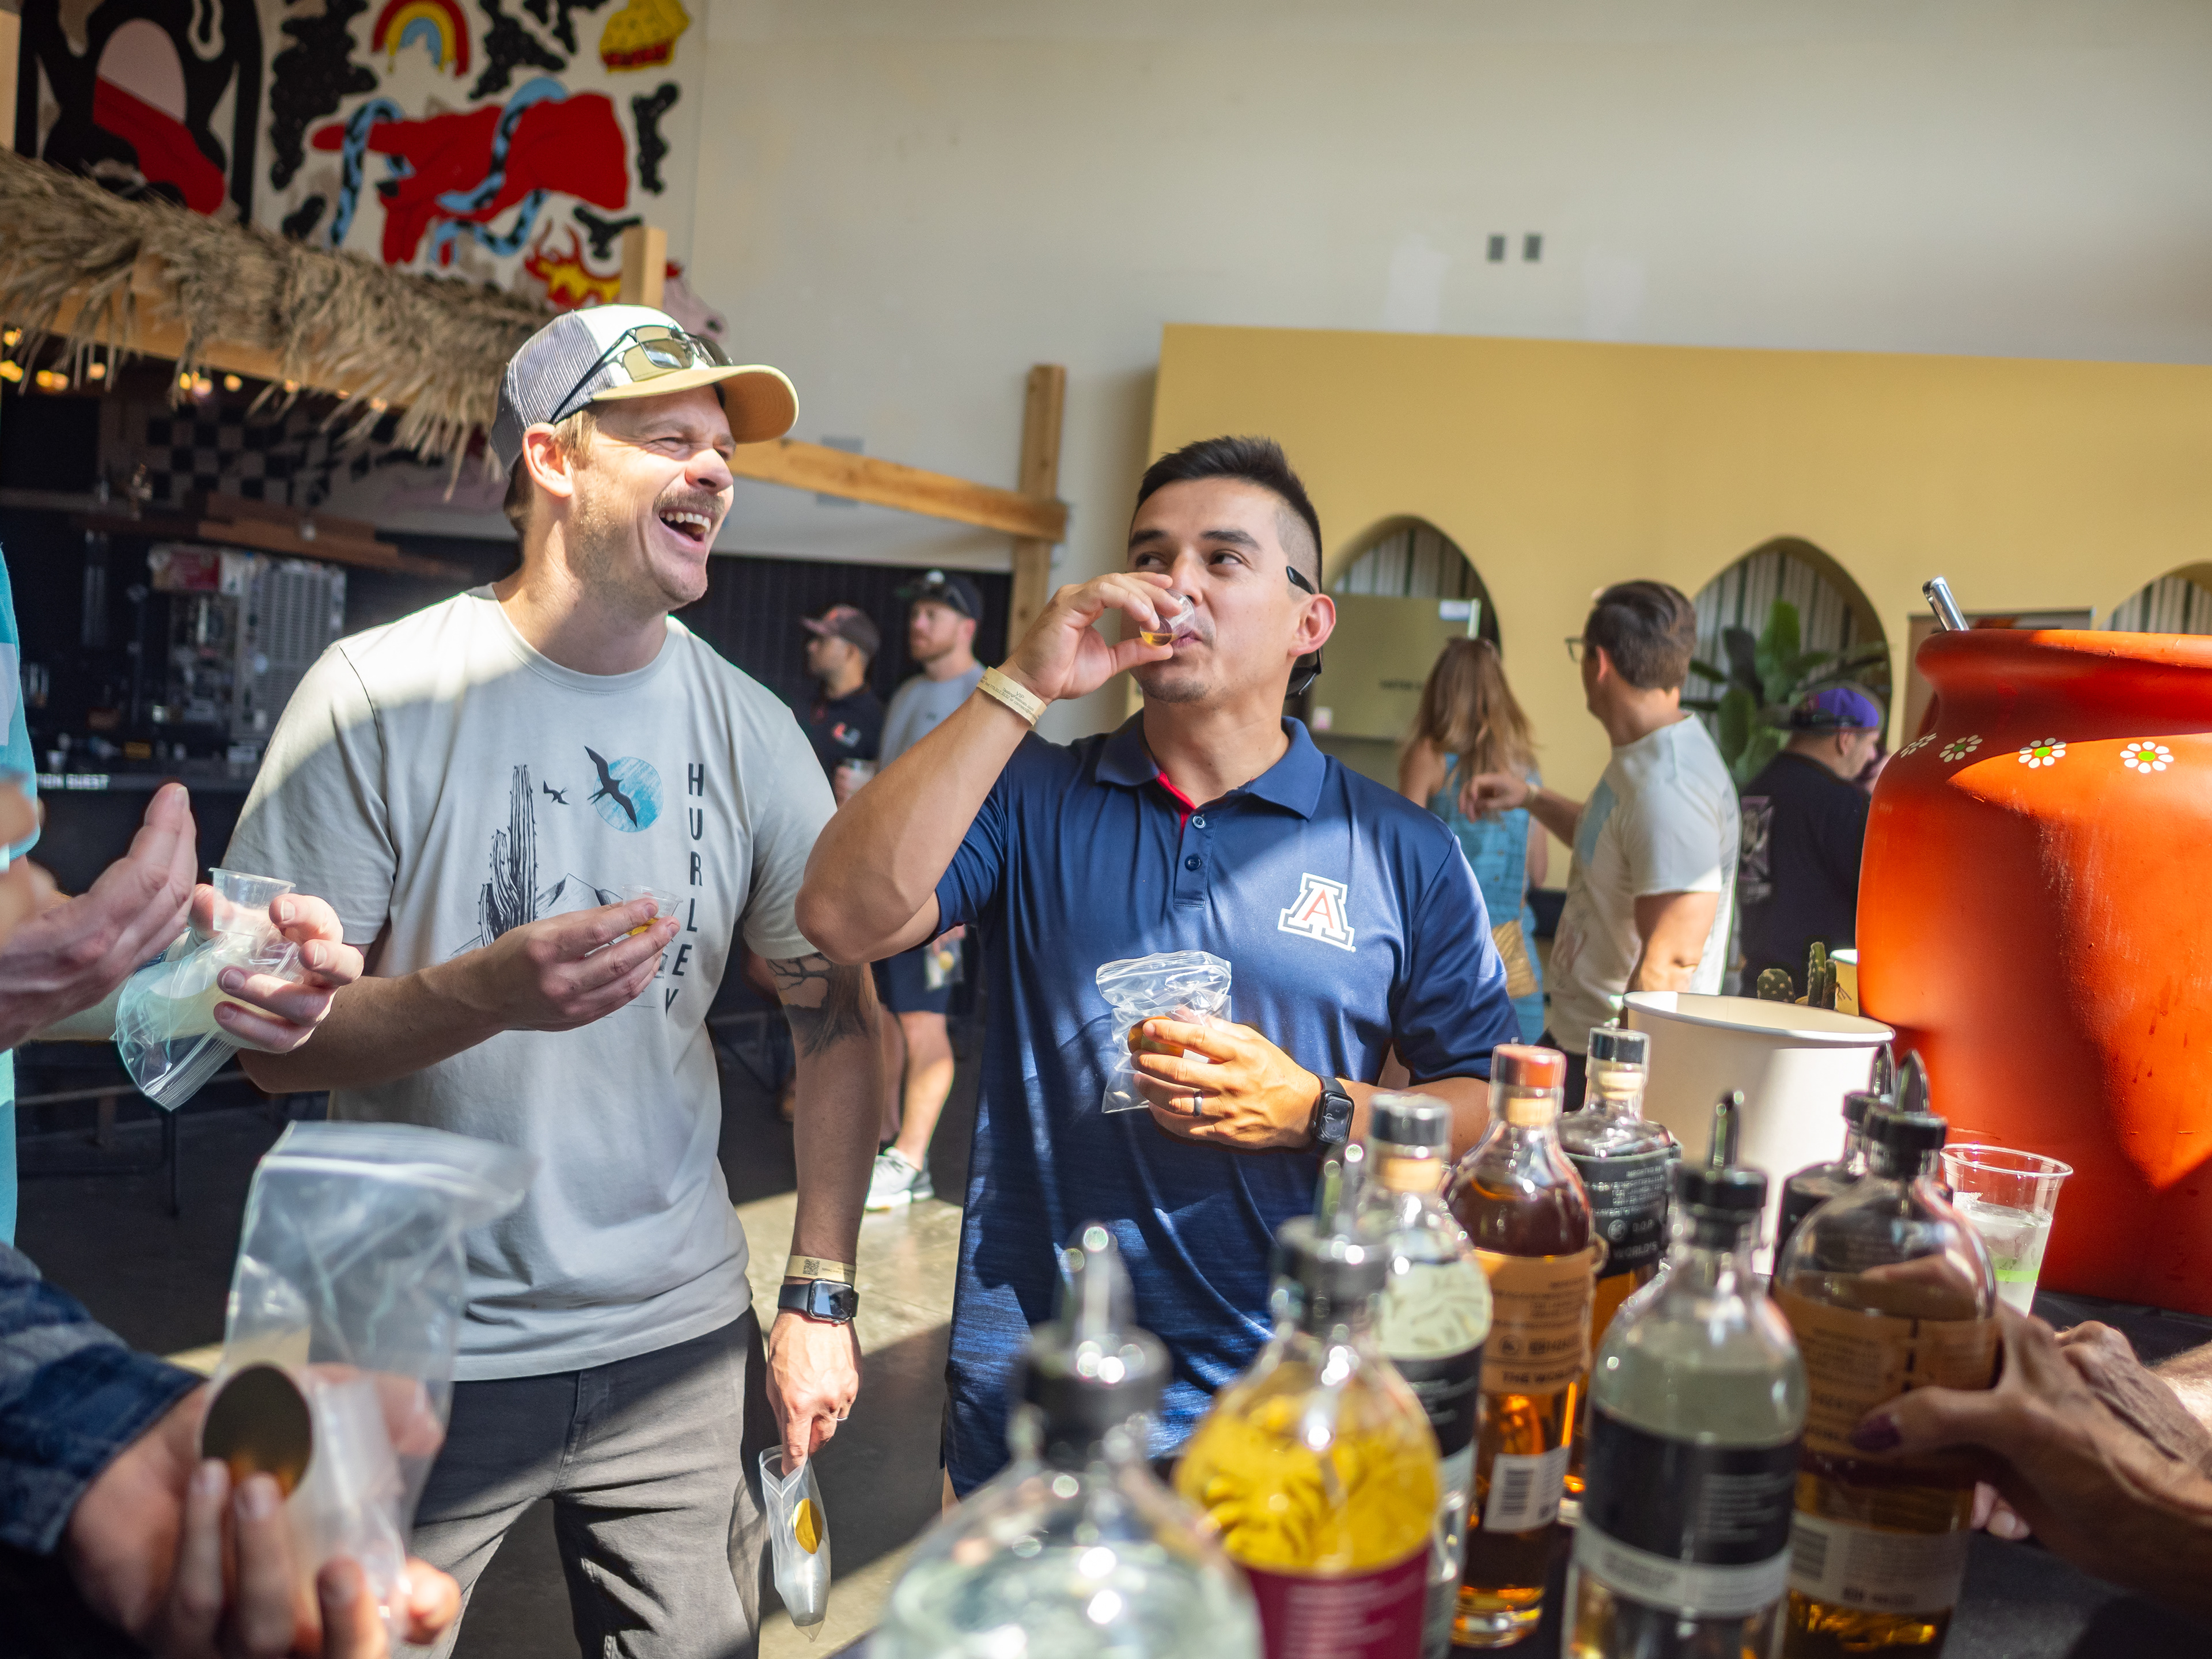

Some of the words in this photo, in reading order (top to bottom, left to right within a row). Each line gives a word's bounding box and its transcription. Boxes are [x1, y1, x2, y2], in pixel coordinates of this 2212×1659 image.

[1003, 687, 1035, 711] TastingFestivals.com
[665, 762, 704, 1018] HURLEY
[1277, 872, 1355, 951] A
